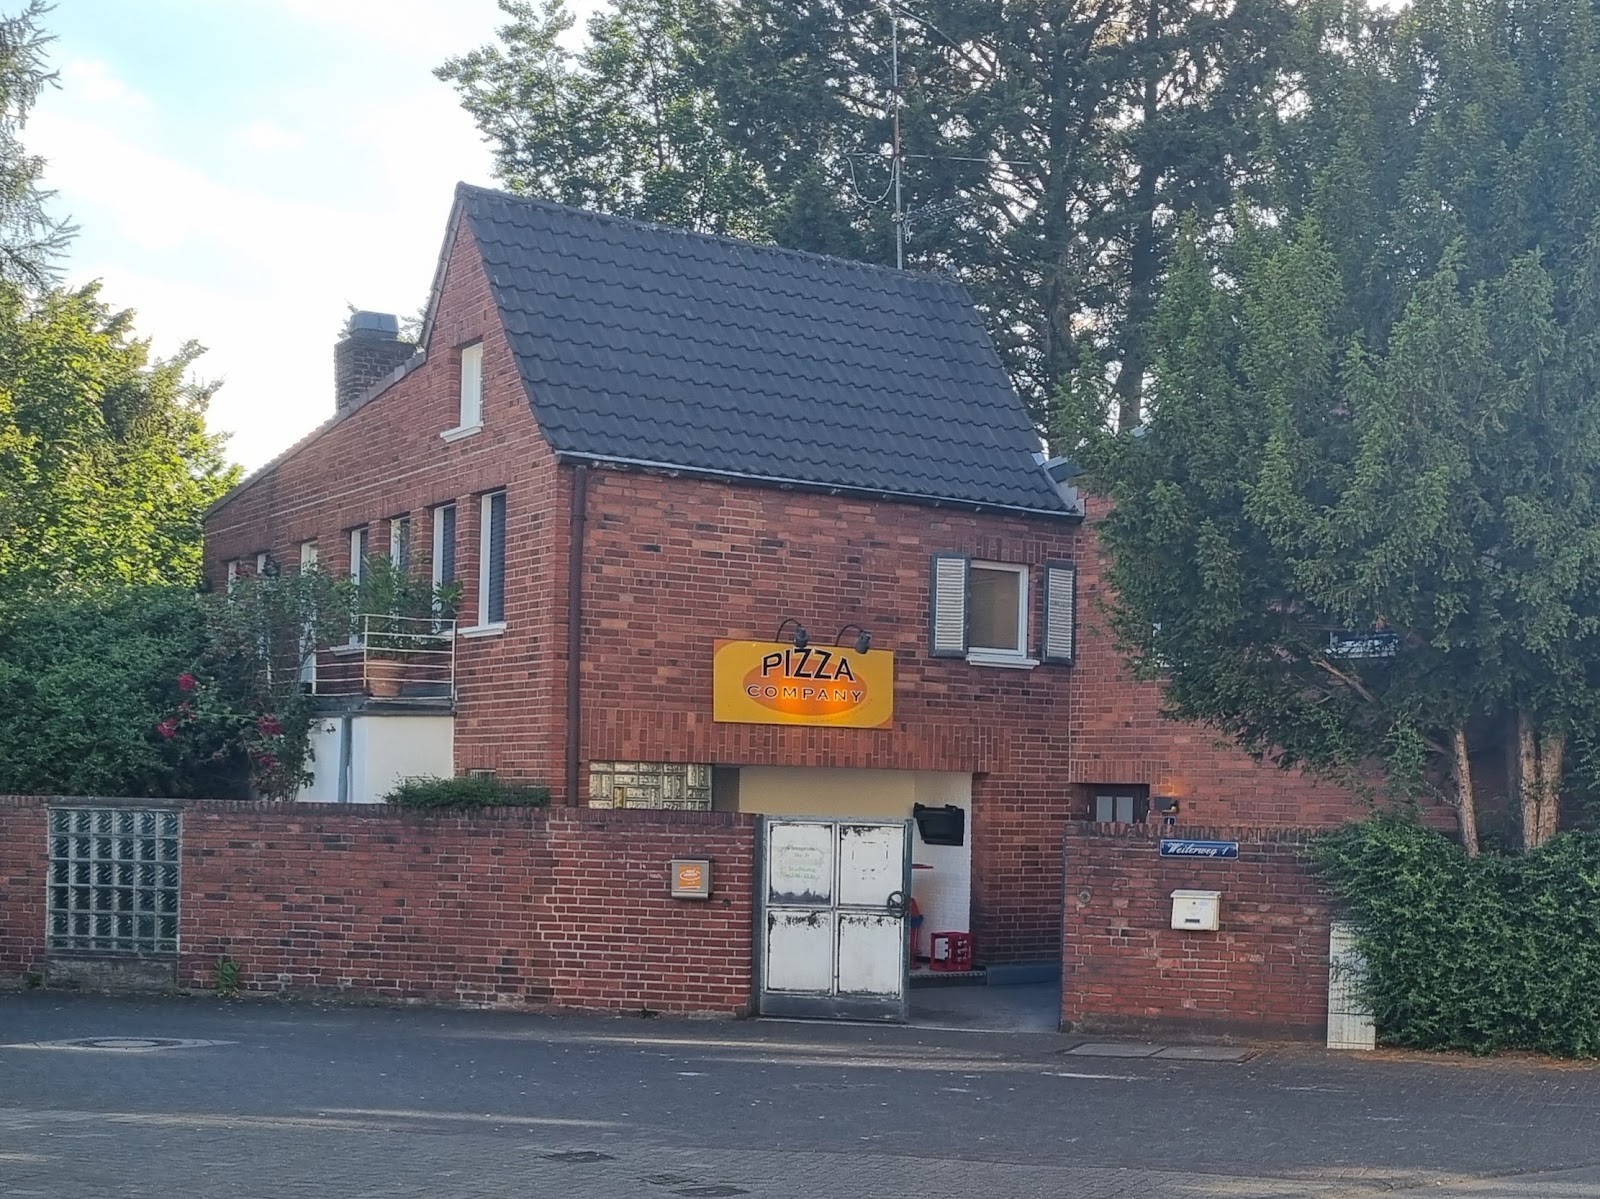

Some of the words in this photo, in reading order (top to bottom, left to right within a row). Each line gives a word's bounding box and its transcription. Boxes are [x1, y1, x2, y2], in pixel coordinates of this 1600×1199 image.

[762, 648, 855, 681] PIZZA
[747, 685, 864, 703] COMPANY
[1167, 843, 1218, 857] Weilerweg
